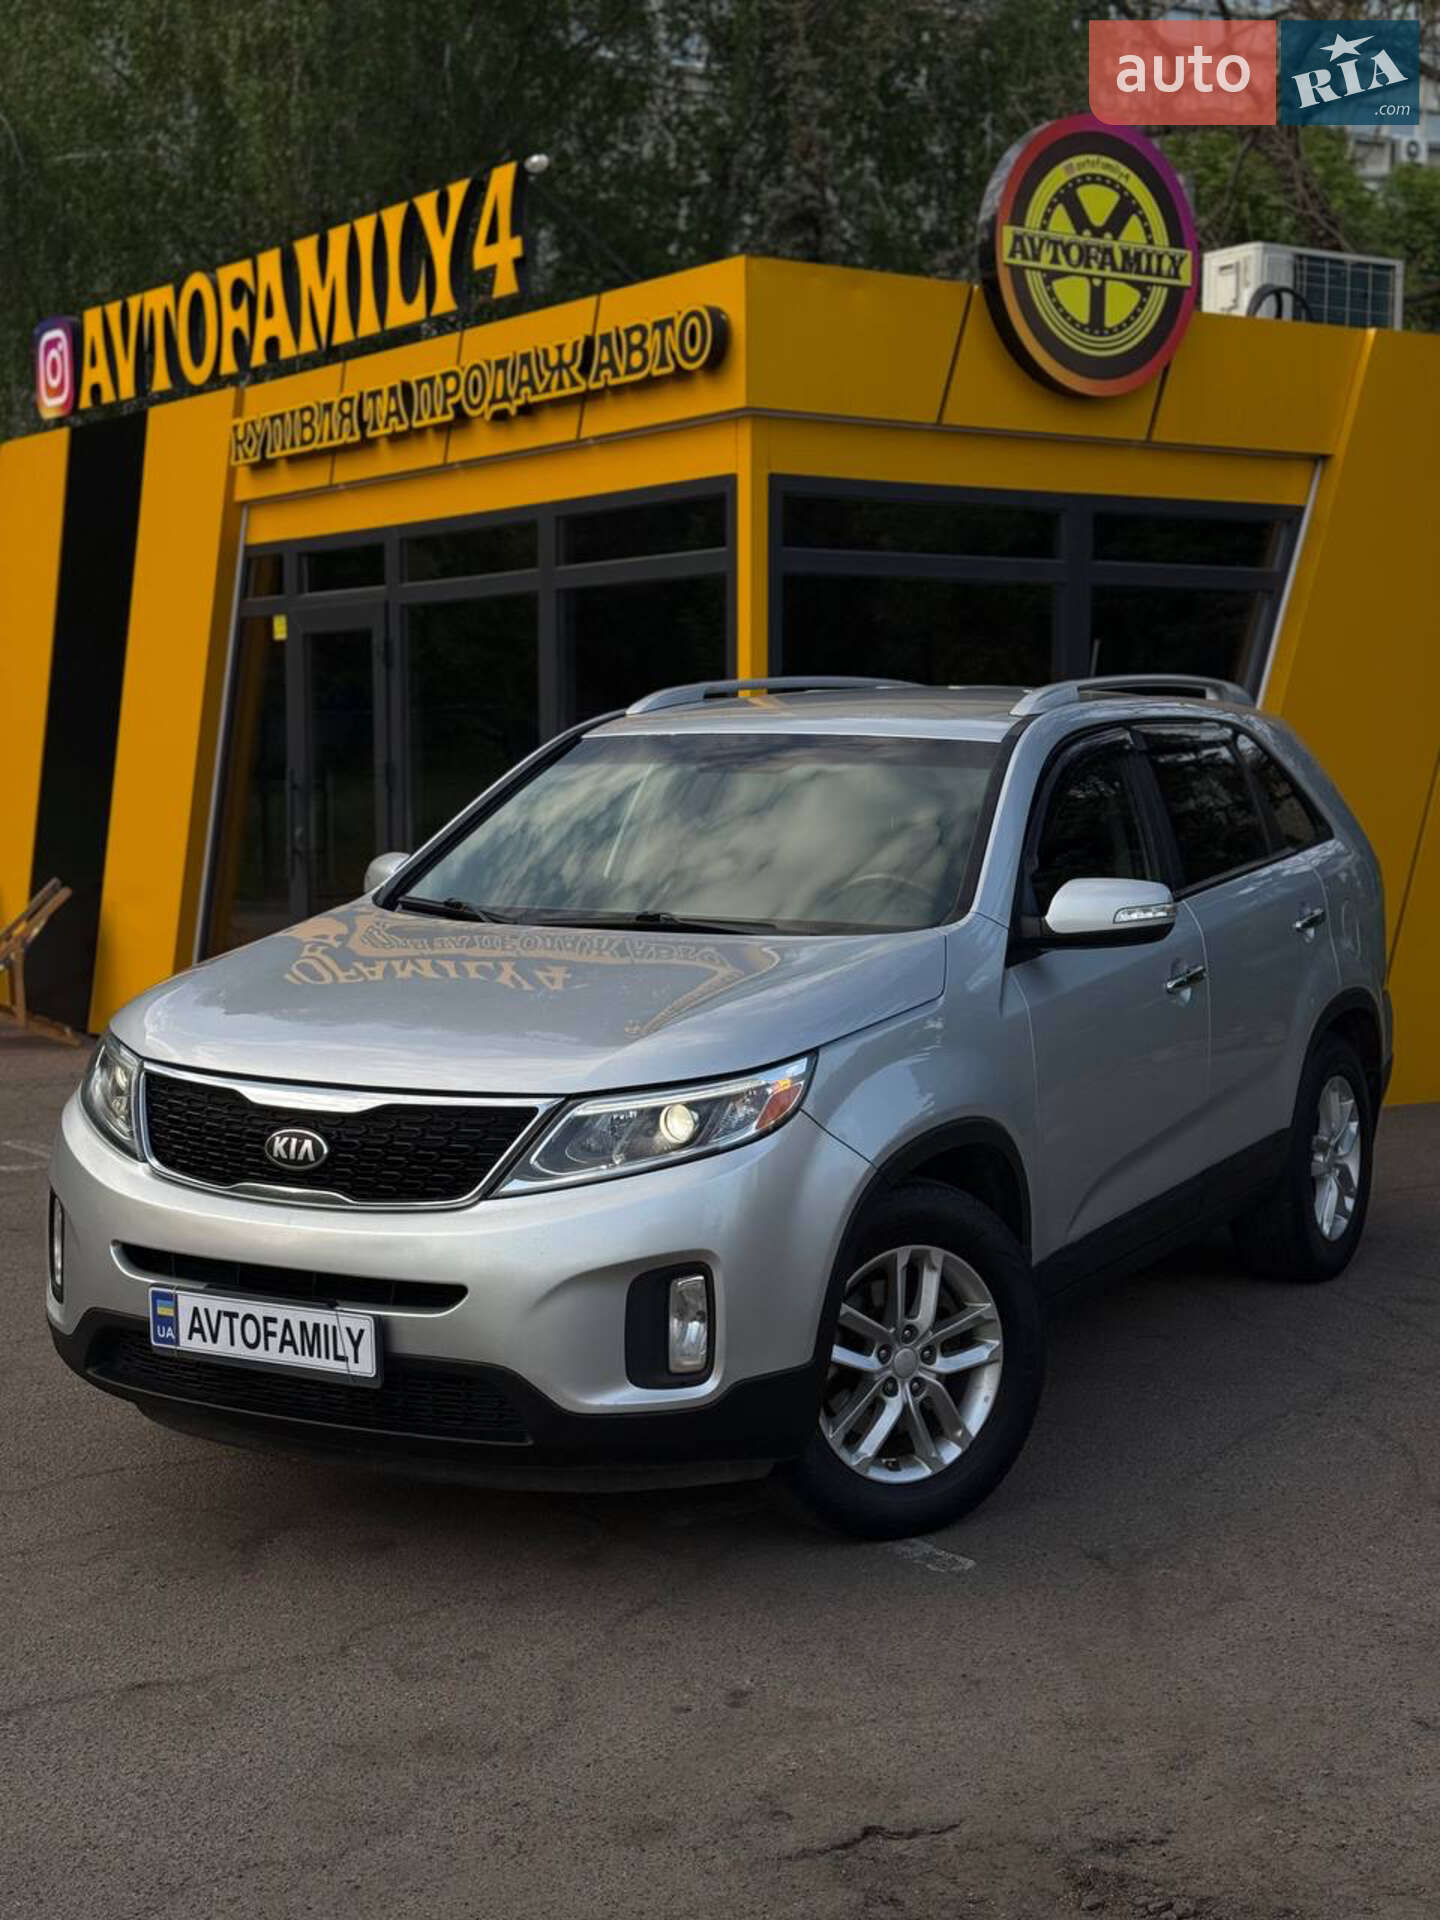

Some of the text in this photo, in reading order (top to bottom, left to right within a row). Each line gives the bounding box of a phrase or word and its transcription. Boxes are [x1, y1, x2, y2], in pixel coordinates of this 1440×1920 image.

[1007, 230, 1188, 281] AVTOFAMILY
[411, 336, 588, 421] ПРОДАЖ
[588, 304, 713, 389] АВТО
[272, 1142, 315, 1163] KIA
[157, 1325, 176, 1340] UA
[187, 1305, 366, 1365] AVTOFAMILY
